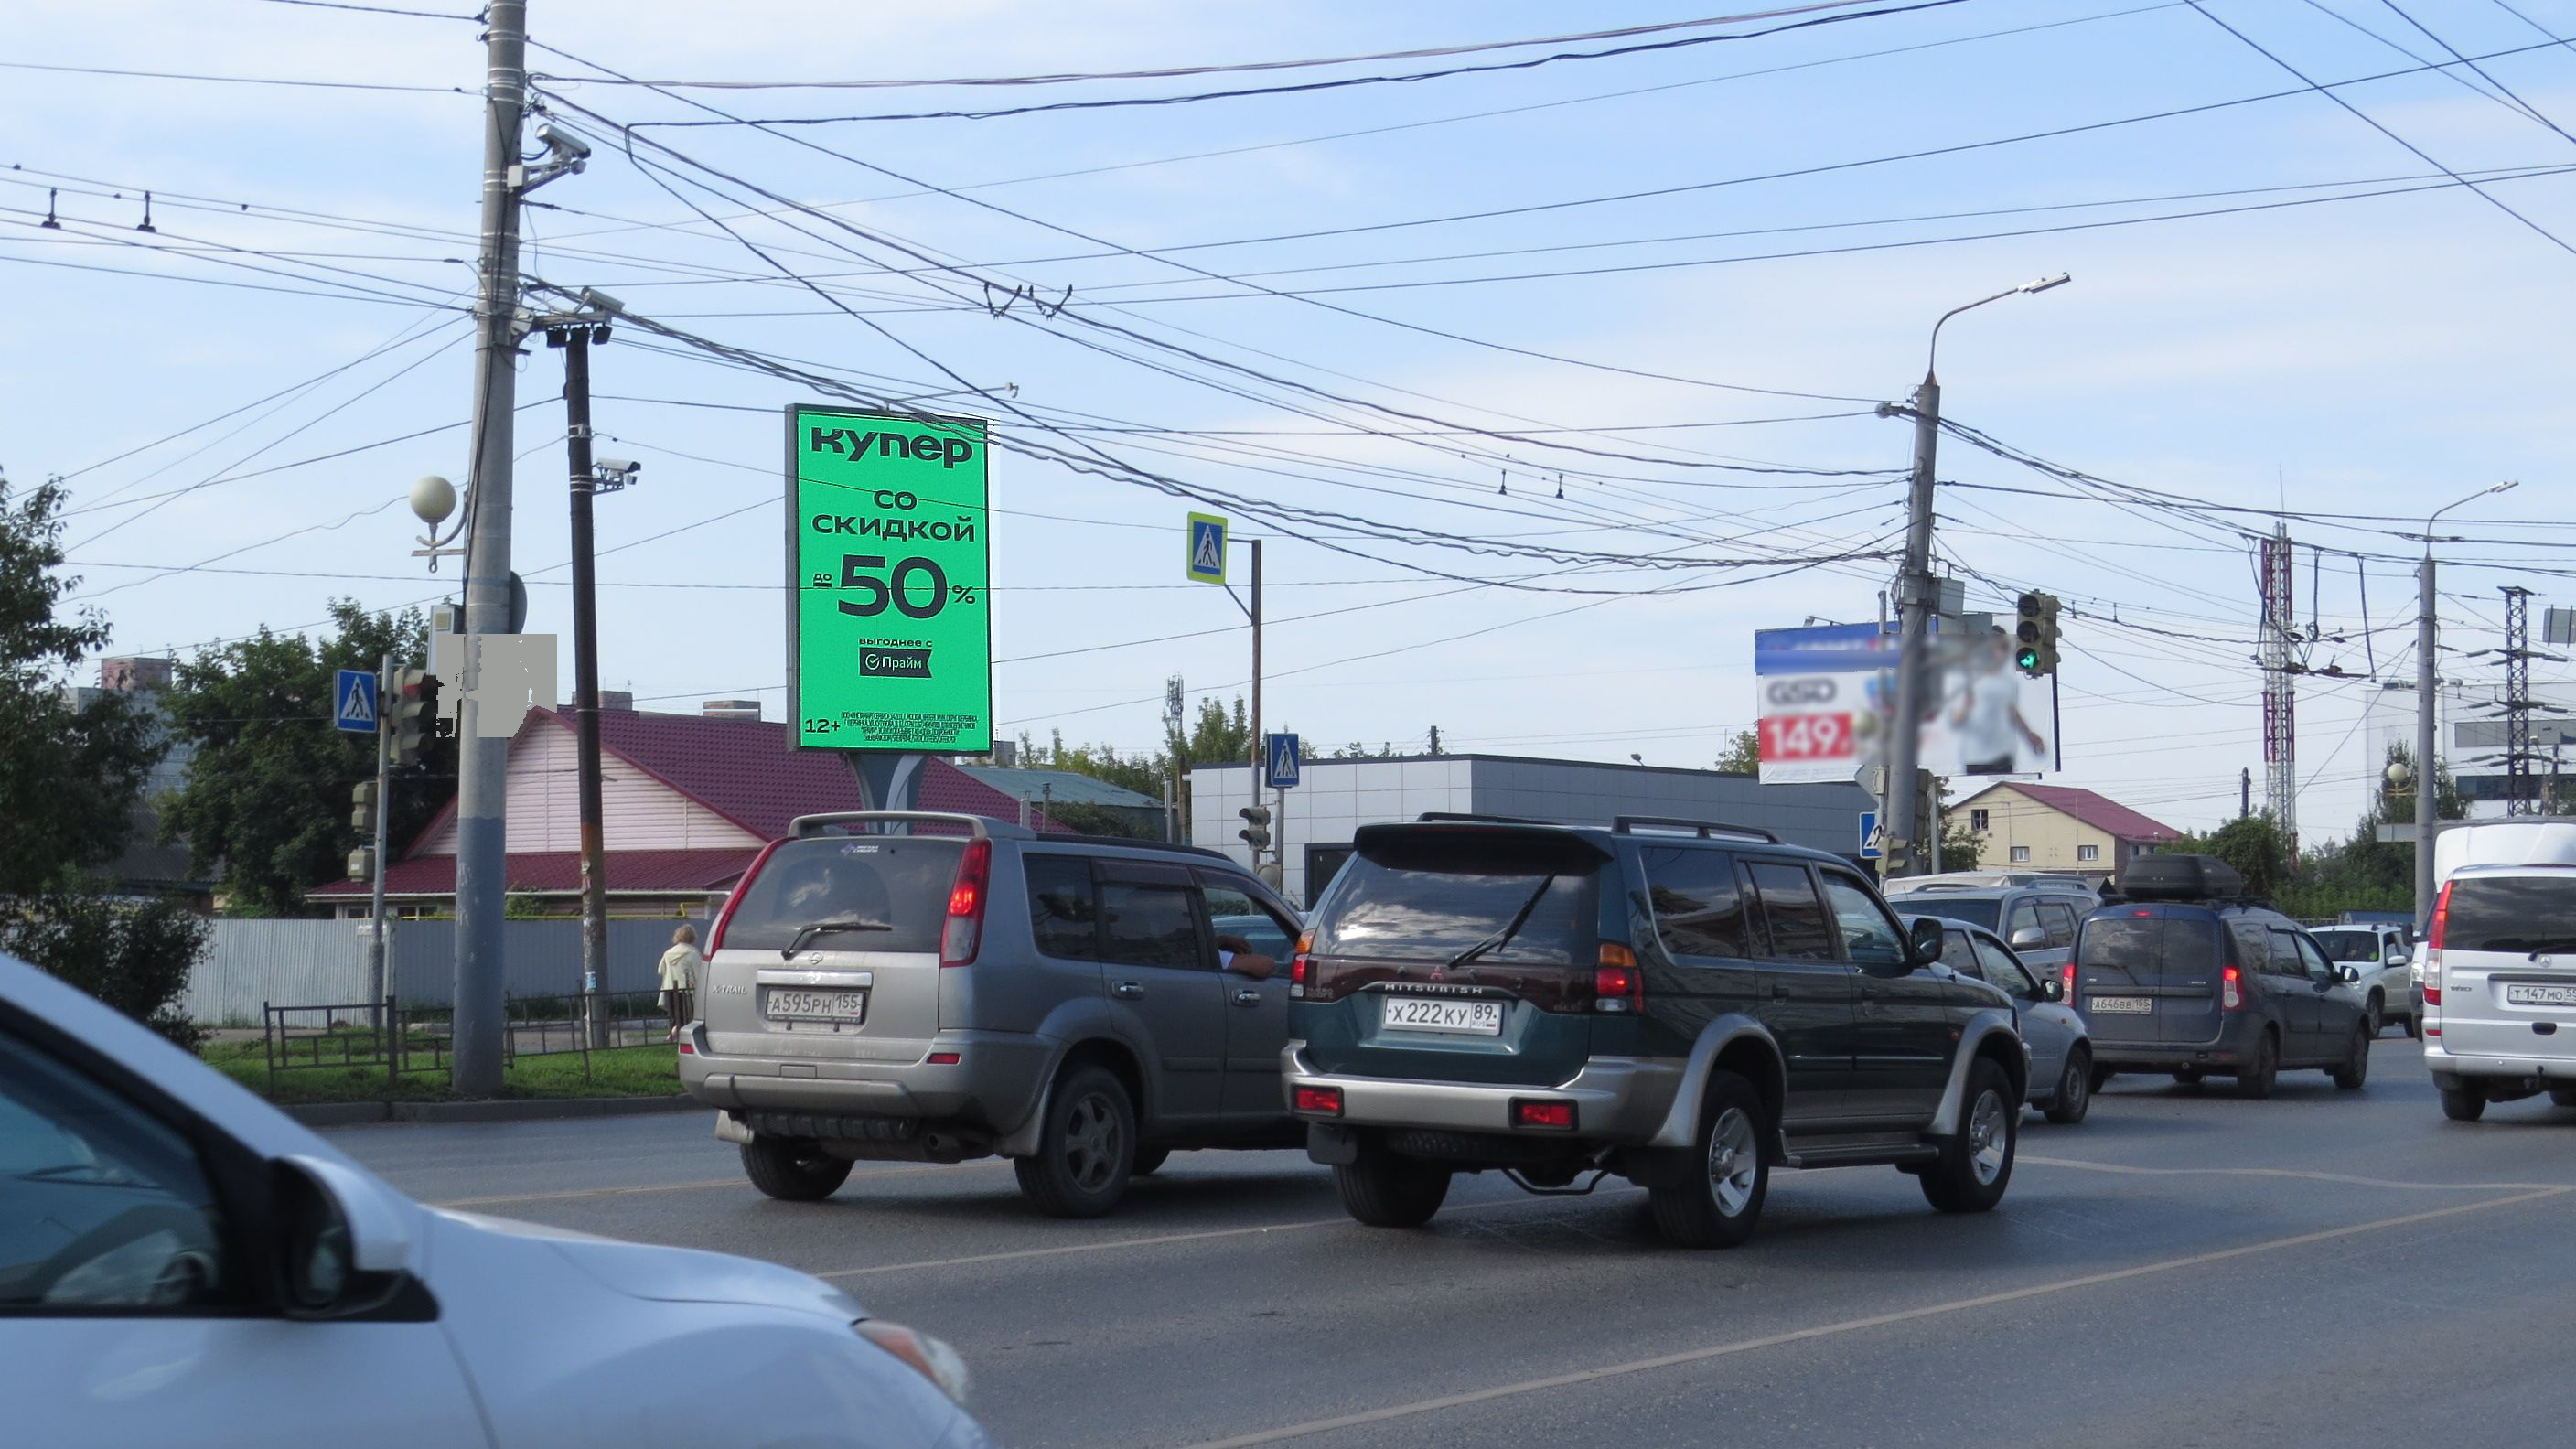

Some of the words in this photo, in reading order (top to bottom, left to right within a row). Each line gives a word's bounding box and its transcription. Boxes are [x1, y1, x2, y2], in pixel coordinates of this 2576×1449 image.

[874, 489, 918, 510] со
[812, 514, 975, 542] скидкой
[813, 573, 832, 583] до
[859, 638, 922, 648] выгоднее
[926, 639, 933, 648] с
[881, 655, 922, 671] Прайм
[805, 718, 841, 733] 12+
[1473, 1004, 1493, 1020] 89
